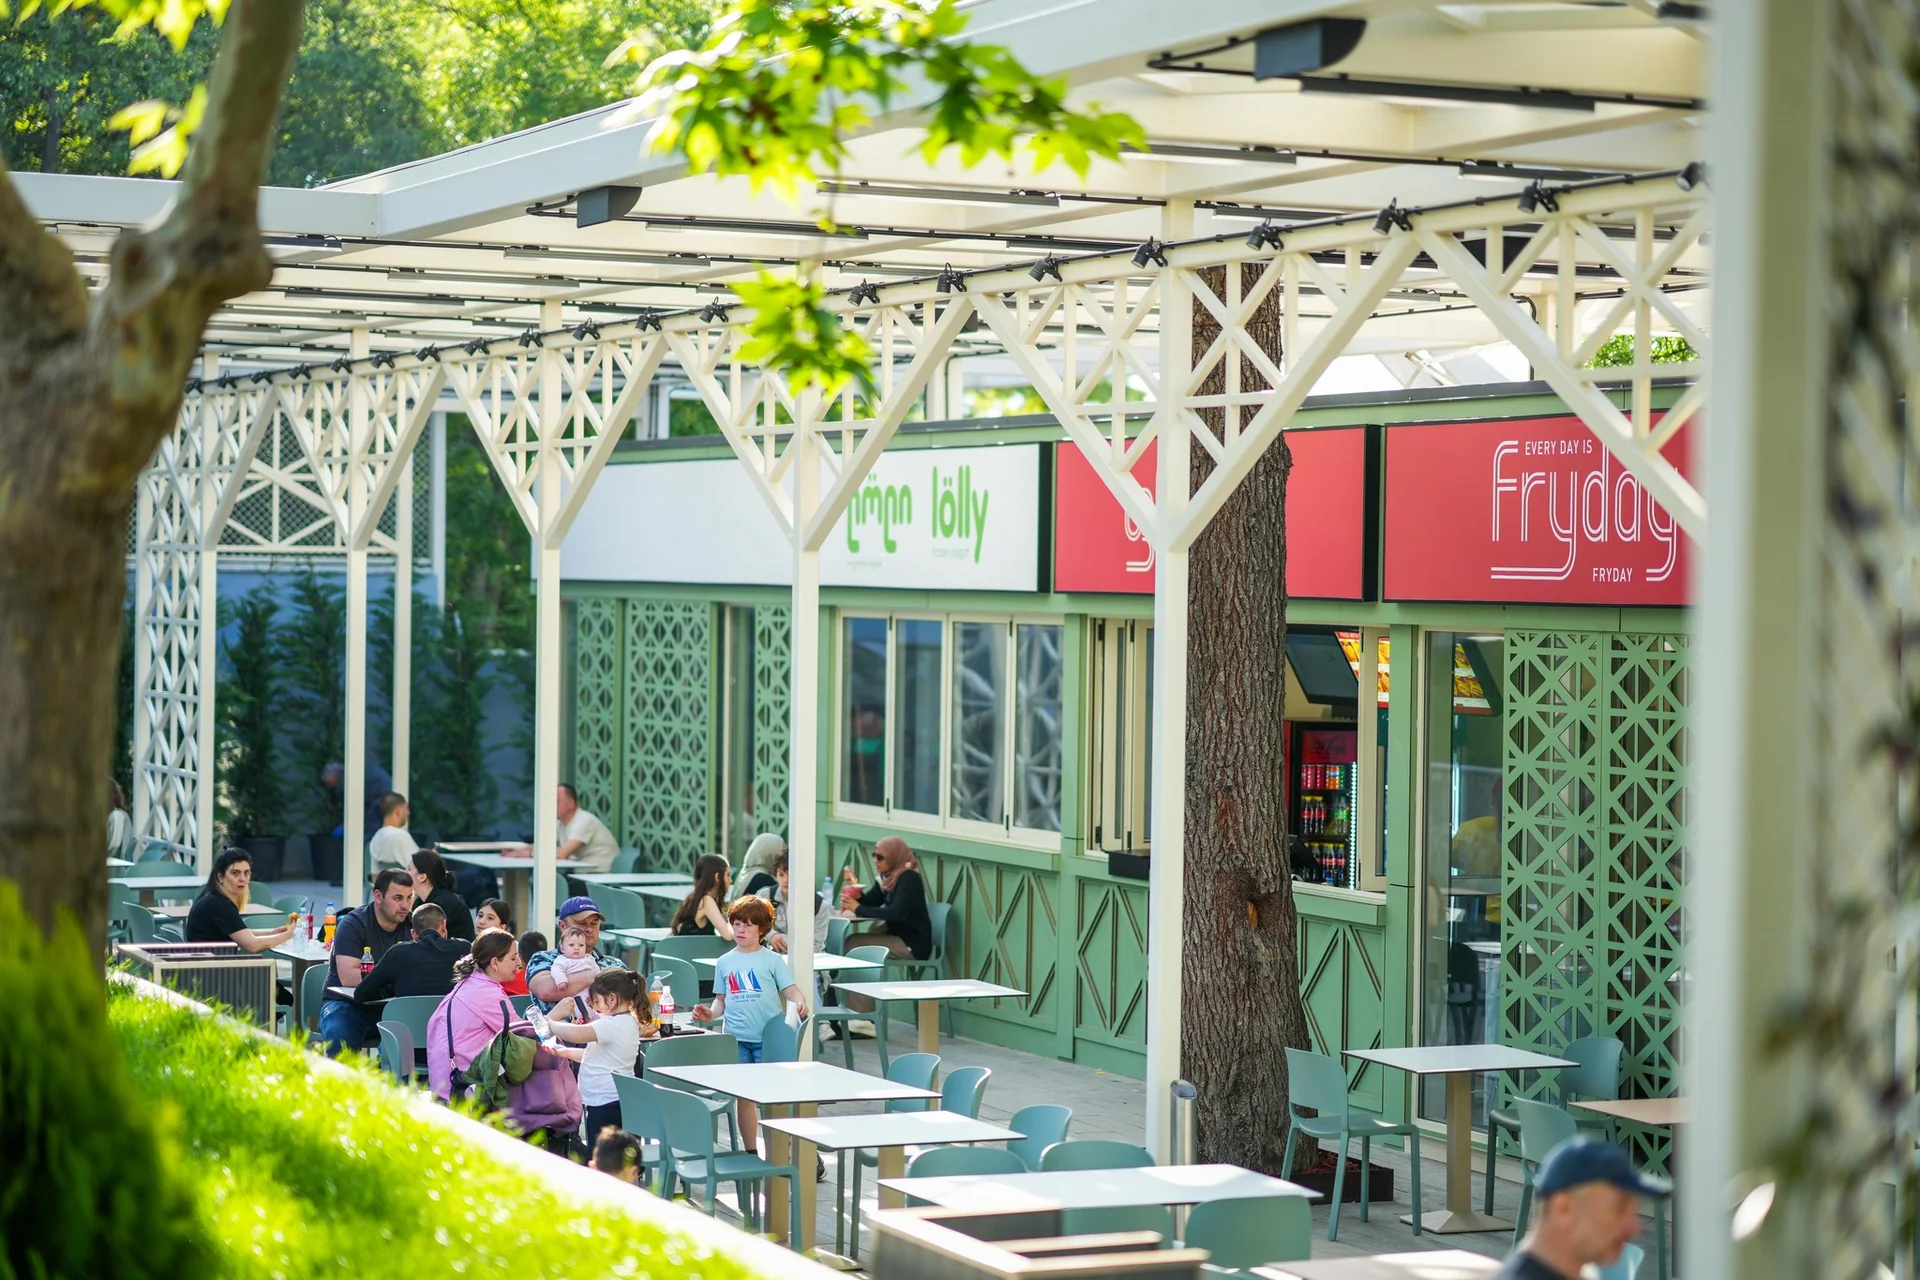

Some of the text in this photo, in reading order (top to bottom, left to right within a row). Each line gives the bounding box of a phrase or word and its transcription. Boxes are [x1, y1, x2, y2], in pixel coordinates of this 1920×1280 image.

[1525, 439, 1593, 456] EVERY DAY IS
[932, 464, 989, 564] lölly
[1592, 567, 1633, 582] FRYDAY
